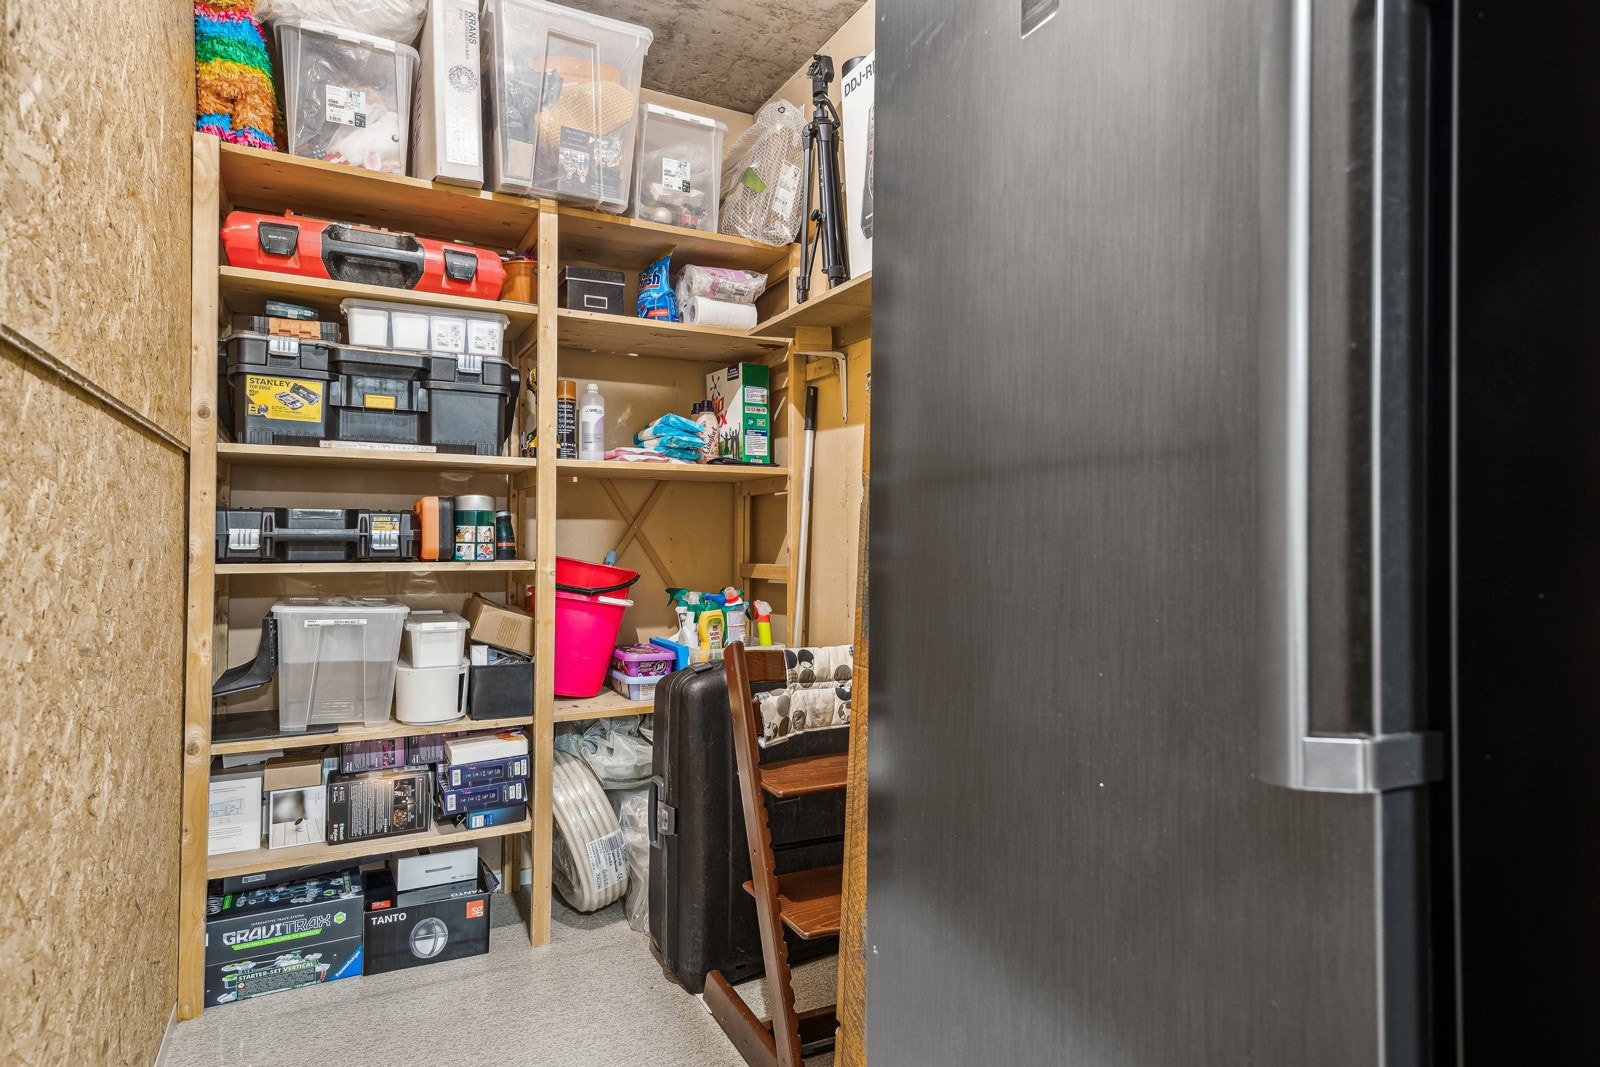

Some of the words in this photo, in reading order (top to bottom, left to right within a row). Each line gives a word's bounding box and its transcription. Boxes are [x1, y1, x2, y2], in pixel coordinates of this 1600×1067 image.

[468, 11, 477, 45] KRANS
[249, 377, 291, 388] STANLEY
[702, 426, 718, 455] Comfort
[222, 913, 331, 946] GRAVITRAX
[251, 918, 276, 926] INTERACTIVE
[371, 912, 407, 926] TANTO
[238, 967, 282, 981] STARTER-SET
[282, 961, 315, 975] VERTICAL
[335, 950, 361, 978] Ravensburger
